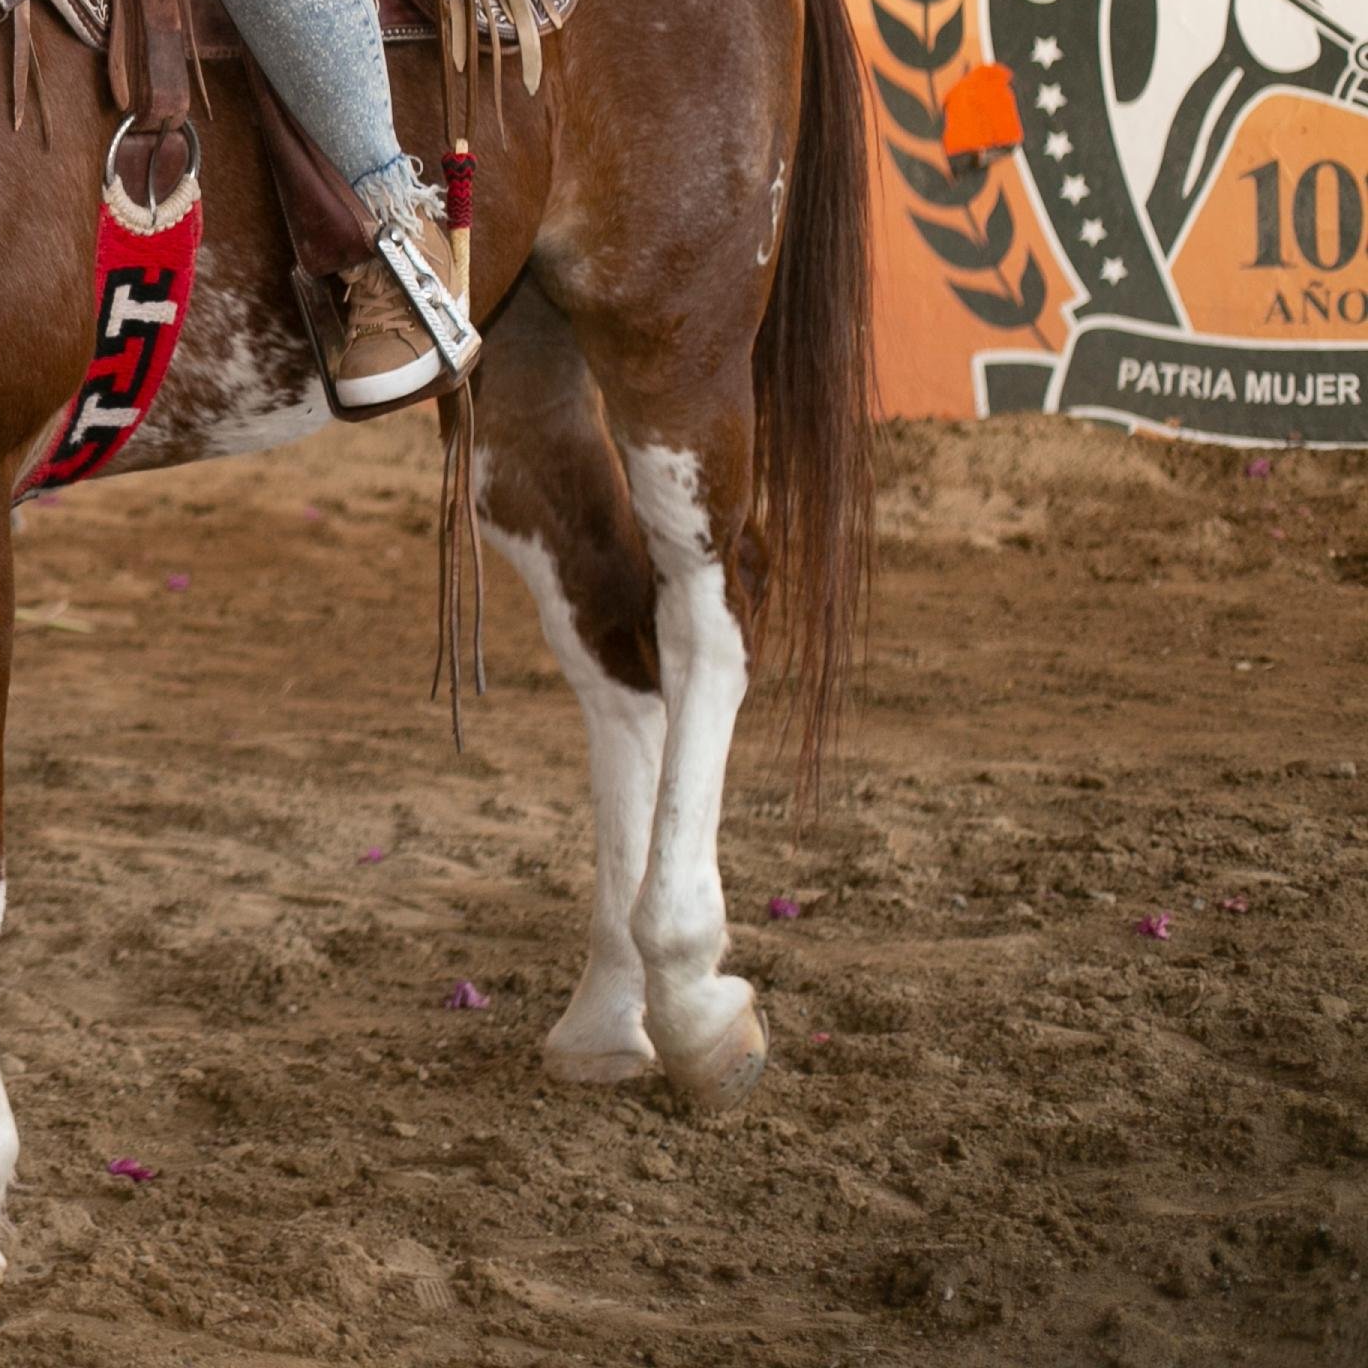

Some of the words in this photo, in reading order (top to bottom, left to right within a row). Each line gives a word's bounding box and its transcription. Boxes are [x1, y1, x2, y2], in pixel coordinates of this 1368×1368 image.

[1238, 158, 1368, 273] 10
[1116, 358, 1237, 403] PATRIA
[1244, 371, 1361, 406] MUJER
